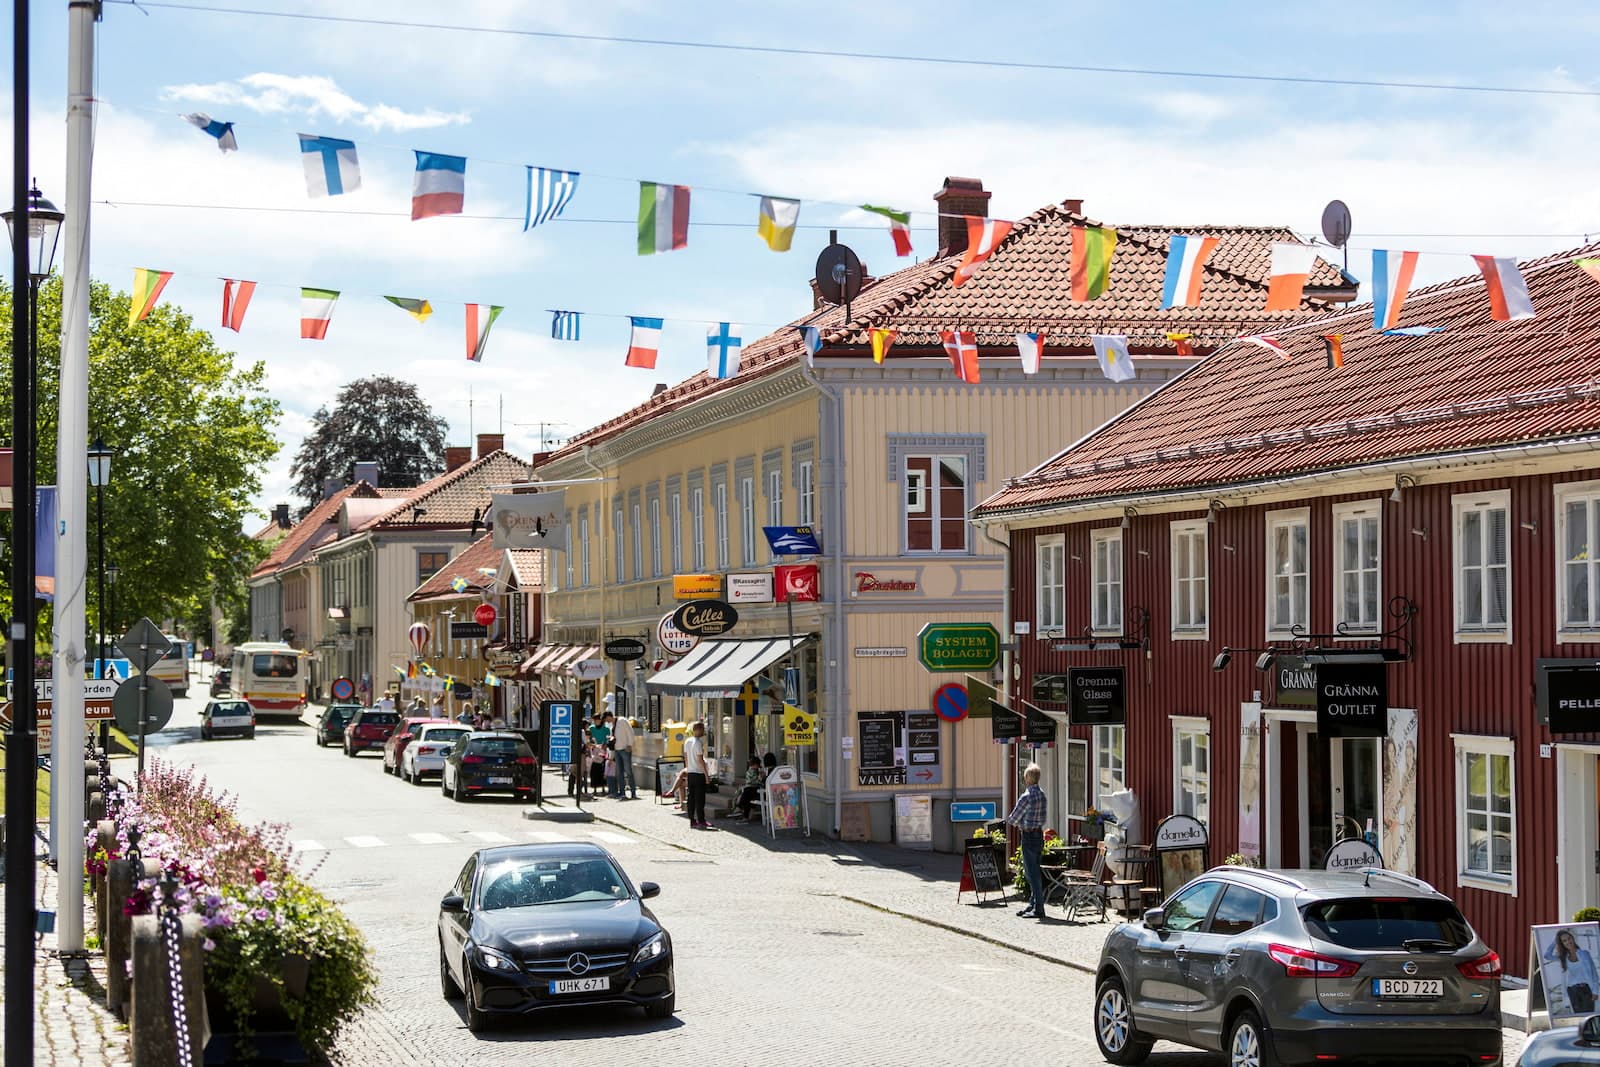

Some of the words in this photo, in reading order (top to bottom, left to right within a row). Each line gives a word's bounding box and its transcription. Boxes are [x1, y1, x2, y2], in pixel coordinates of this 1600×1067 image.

[682, 606, 723, 629] Calles
[935, 637, 987, 647] SYSTEM
[932, 648, 992, 659] BOLAGET
[1076, 676, 1118, 686] Grenna
[1082, 690, 1112, 700] Glass
[1324, 684, 1379, 697] GRÄNNA
[555, 706, 567, 724] P
[1328, 703, 1377, 716] OUTLET
[859, 775, 906, 785] VALVET
[1161, 827, 1200, 840] damella
[1331, 852, 1375, 867] damella
[560, 980, 581, 991] UHK
[584, 978, 604, 989] 671
[1385, 980, 1409, 993] BCD
[1413, 981, 1438, 993] 722
